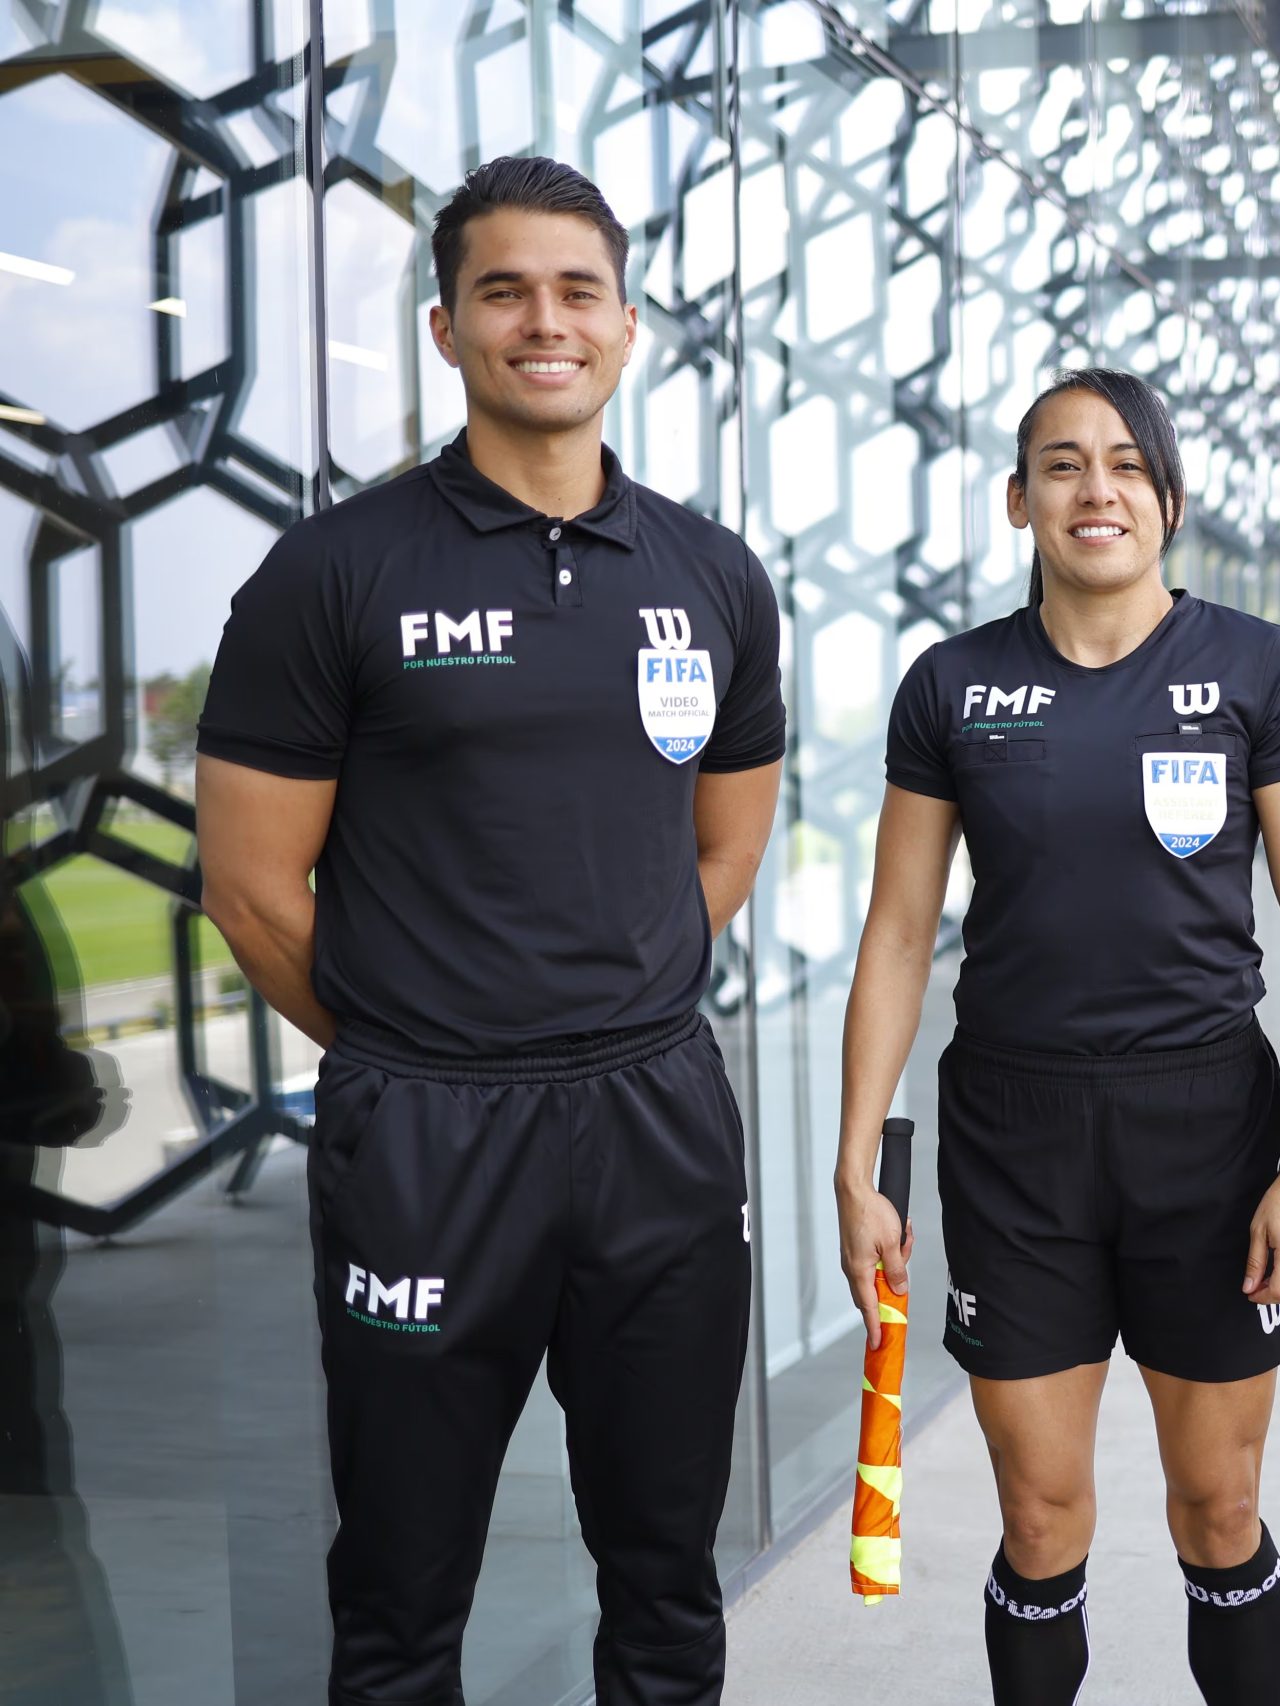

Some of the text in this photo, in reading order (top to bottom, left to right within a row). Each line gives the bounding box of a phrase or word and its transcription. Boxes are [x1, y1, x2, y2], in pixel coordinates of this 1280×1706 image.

[400, 609, 514, 657] FMF
[638, 607, 692, 649] W
[403, 654, 516, 670] POR NUESTRO FÚTBOL
[646, 657, 707, 683] FIFA
[660, 696, 699, 708] VIDEO
[963, 684, 1057, 720] FMF
[1167, 681, 1221, 716] W
[648, 709, 710, 719] MATCH OFFICIAL
[974, 721, 1012, 730] NUESTRO
[1013, 720, 1045, 728] FÚTBOL
[666, 738, 695, 753] 2024
[1151, 759, 1220, 785] FIFA
[1170, 836, 1200, 849] 2024
[345, 1263, 445, 1319] FMF
[347, 1308, 442, 1334] POR NUESTRO FÚTBOL
